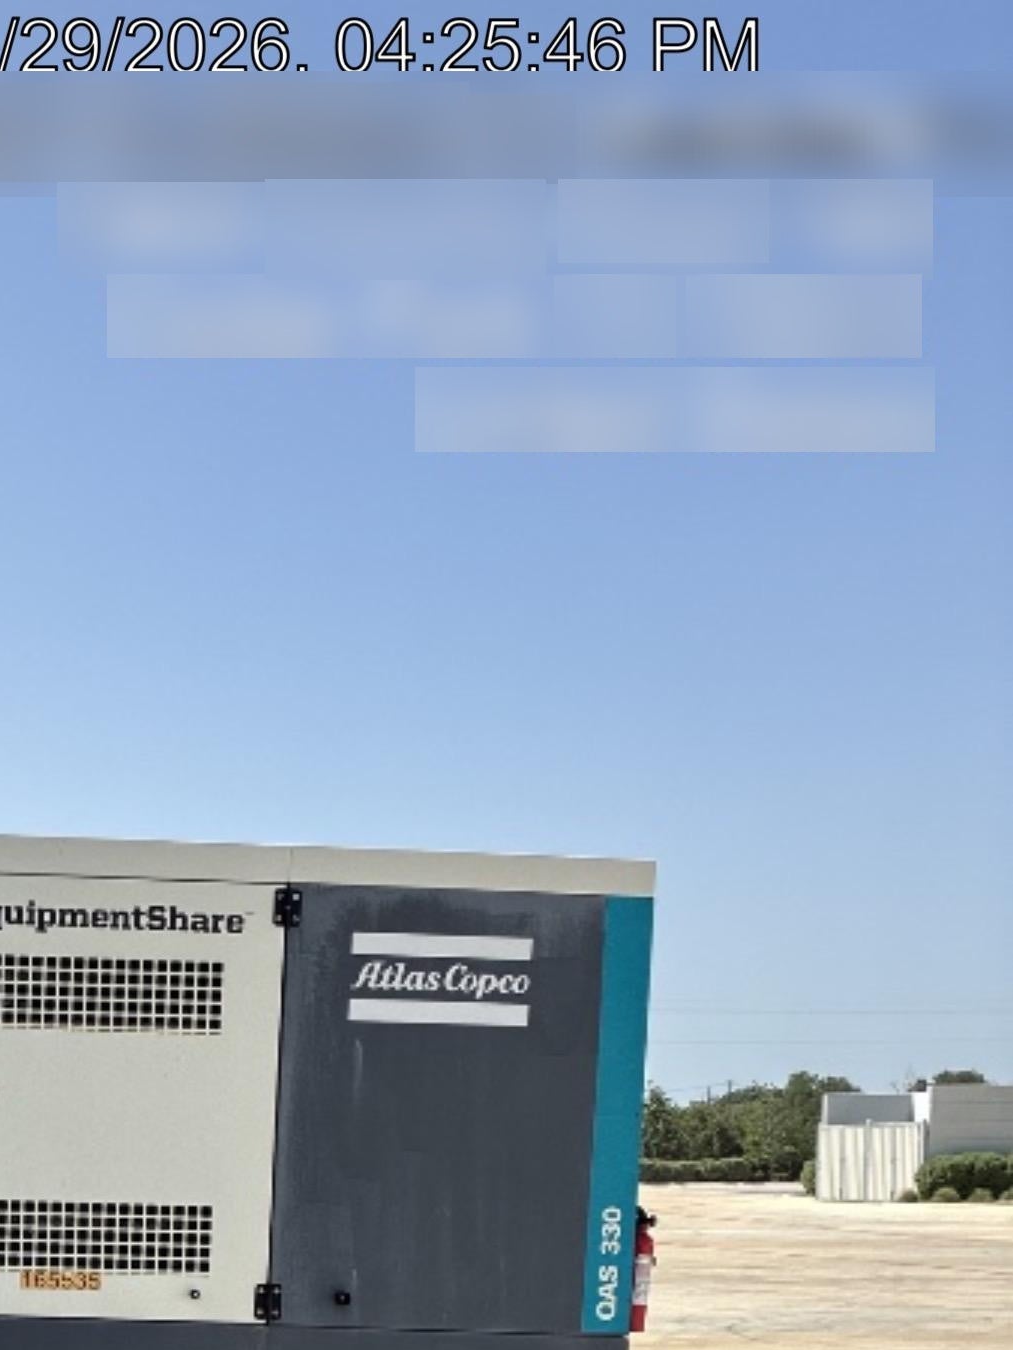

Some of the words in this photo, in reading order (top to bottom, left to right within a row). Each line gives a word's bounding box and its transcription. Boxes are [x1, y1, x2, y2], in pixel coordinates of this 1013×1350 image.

[350, 960, 441, 992] Atlas
[444, 962, 531, 1000] Copco
[601, 1206, 622, 1255] 330
[596, 1265, 619, 1321] QAS
